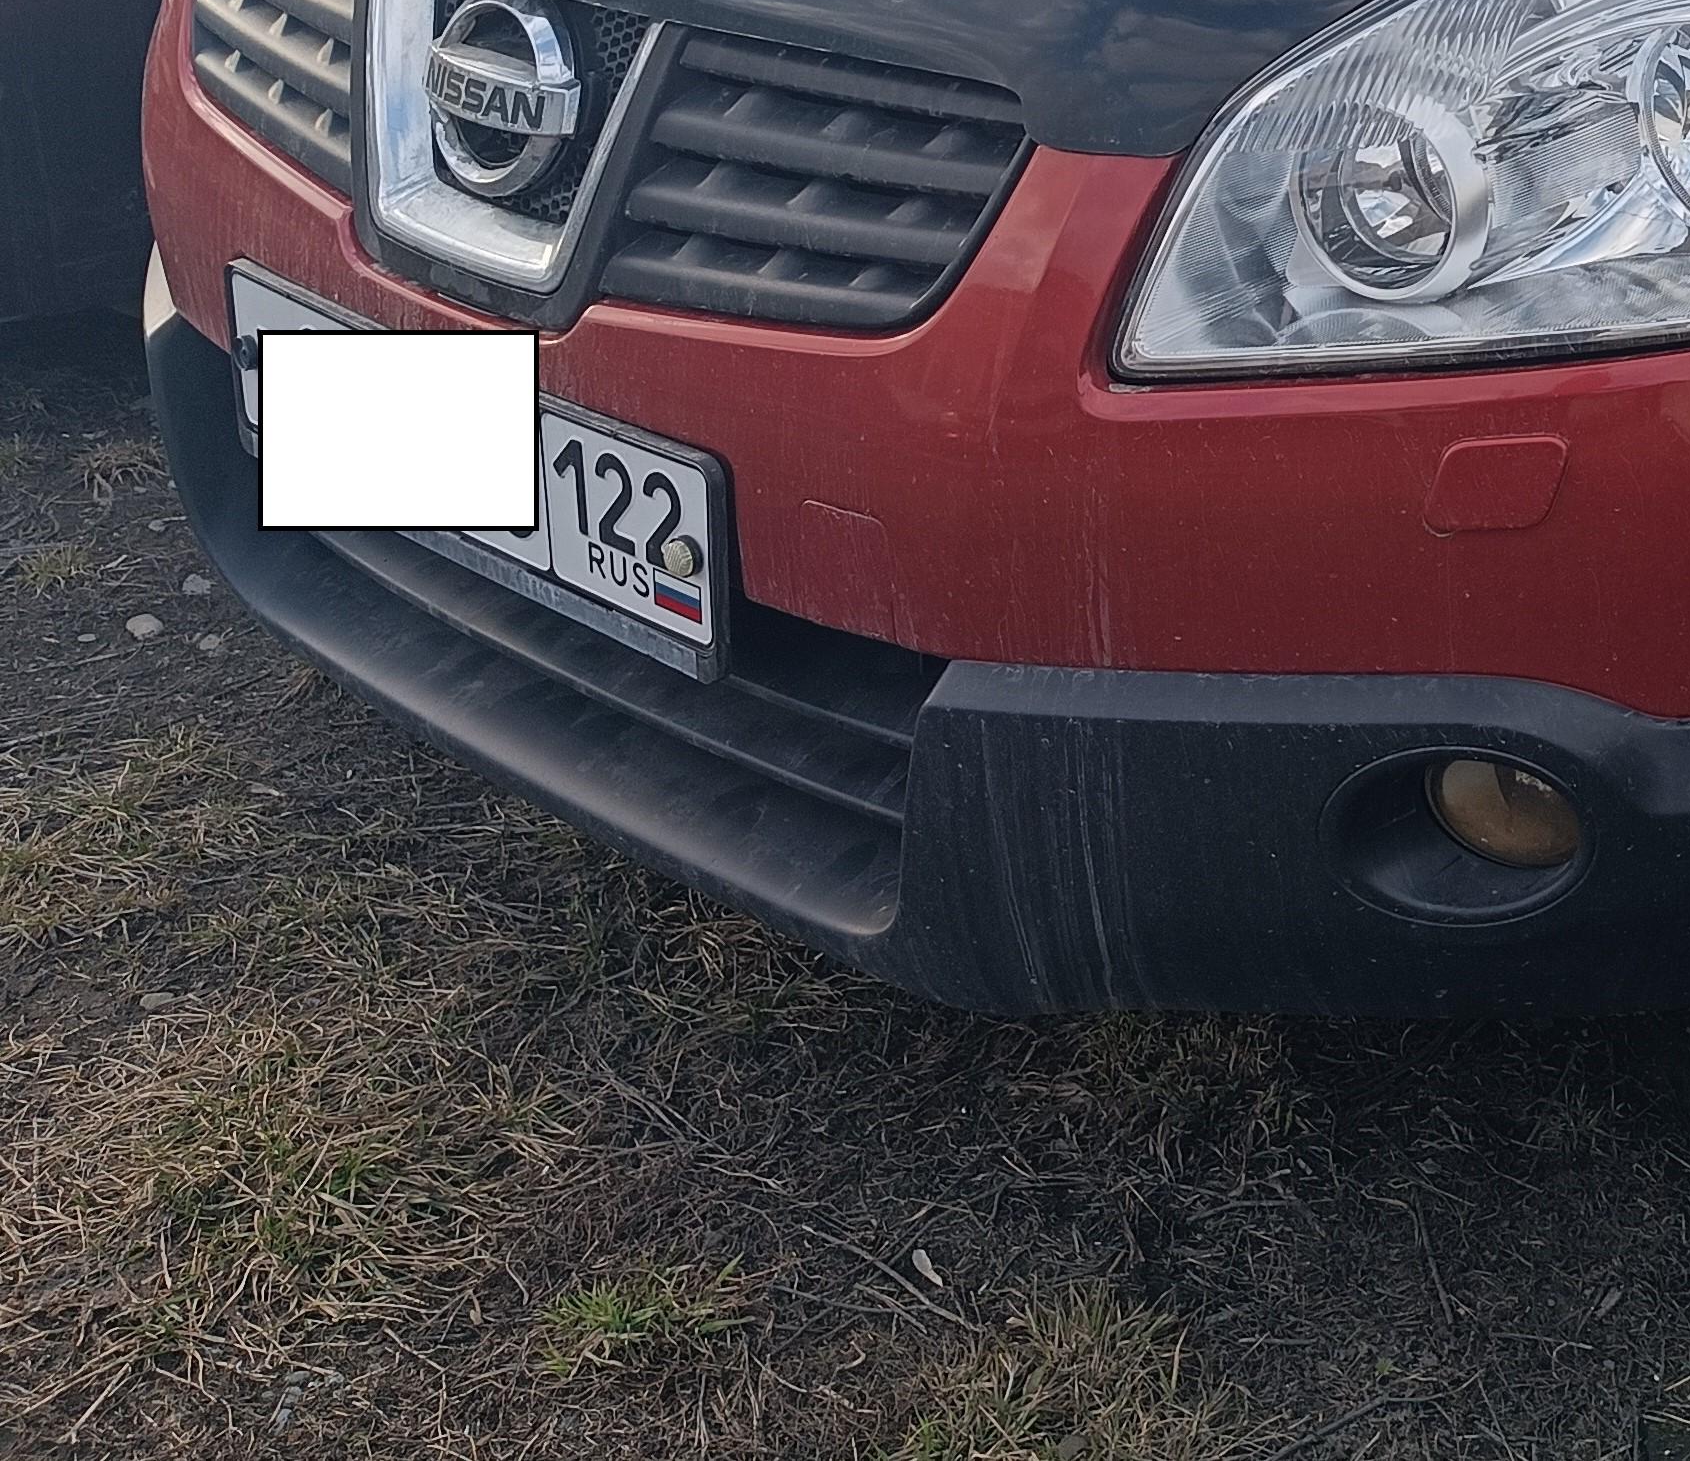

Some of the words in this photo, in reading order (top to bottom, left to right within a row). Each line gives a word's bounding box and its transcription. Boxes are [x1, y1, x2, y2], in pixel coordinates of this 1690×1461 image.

[425, 65, 547, 130] NISSAN
[552, 439, 684, 570] 122
[588, 541, 650, 599] RUS
